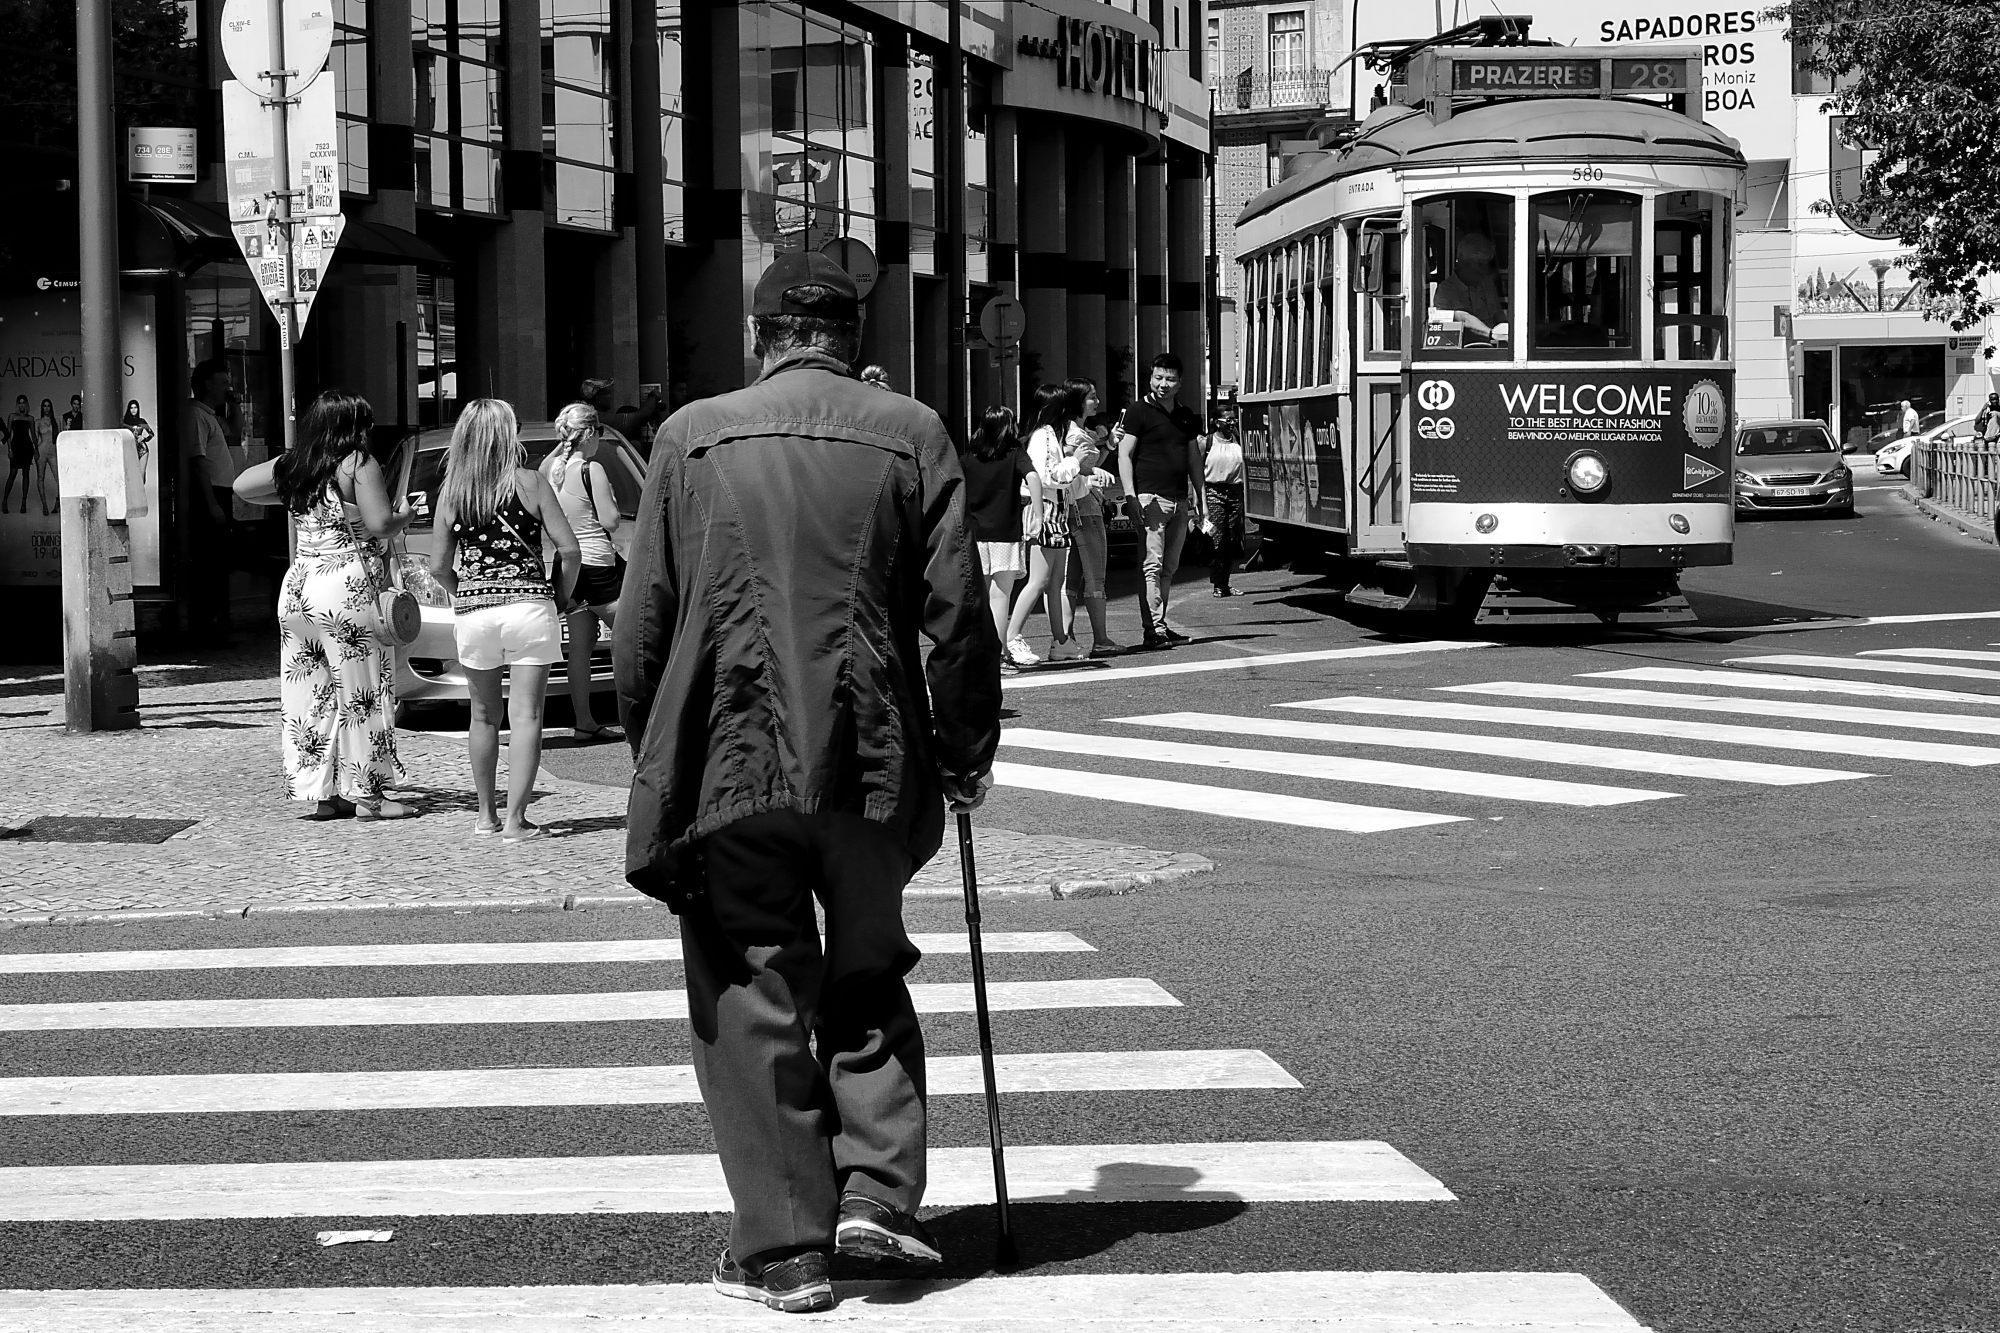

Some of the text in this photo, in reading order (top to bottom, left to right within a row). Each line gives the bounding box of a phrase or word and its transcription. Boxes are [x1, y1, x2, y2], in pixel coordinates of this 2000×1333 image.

[1600, 11, 1755, 42] SAPADORES
[1058, 16, 1144, 104] HOTEL
[1470, 65, 1594, 85] PRAZERES
[1630, 63, 1675, 89] 28
[1714, 70, 1756, 85] Moniz
[1572, 167, 1603, 181] 580
[1348, 182, 1374, 195] ENTRADA
[1427, 336, 1440, 345] 07
[1499, 383, 1671, 415] WELCOME
[1509, 417, 1661, 429] TO THE BEST PLACE IN FASHION
[1508, 432, 1552, 440] BEM-VINDO
[1554, 432, 1567, 440] AO
[1568, 433, 1599, 441] MELHOR
[1601, 433, 1625, 441] LUGAR
[1639, 434, 1662, 442] MODA
[31, 535, 61, 547] DOMING
